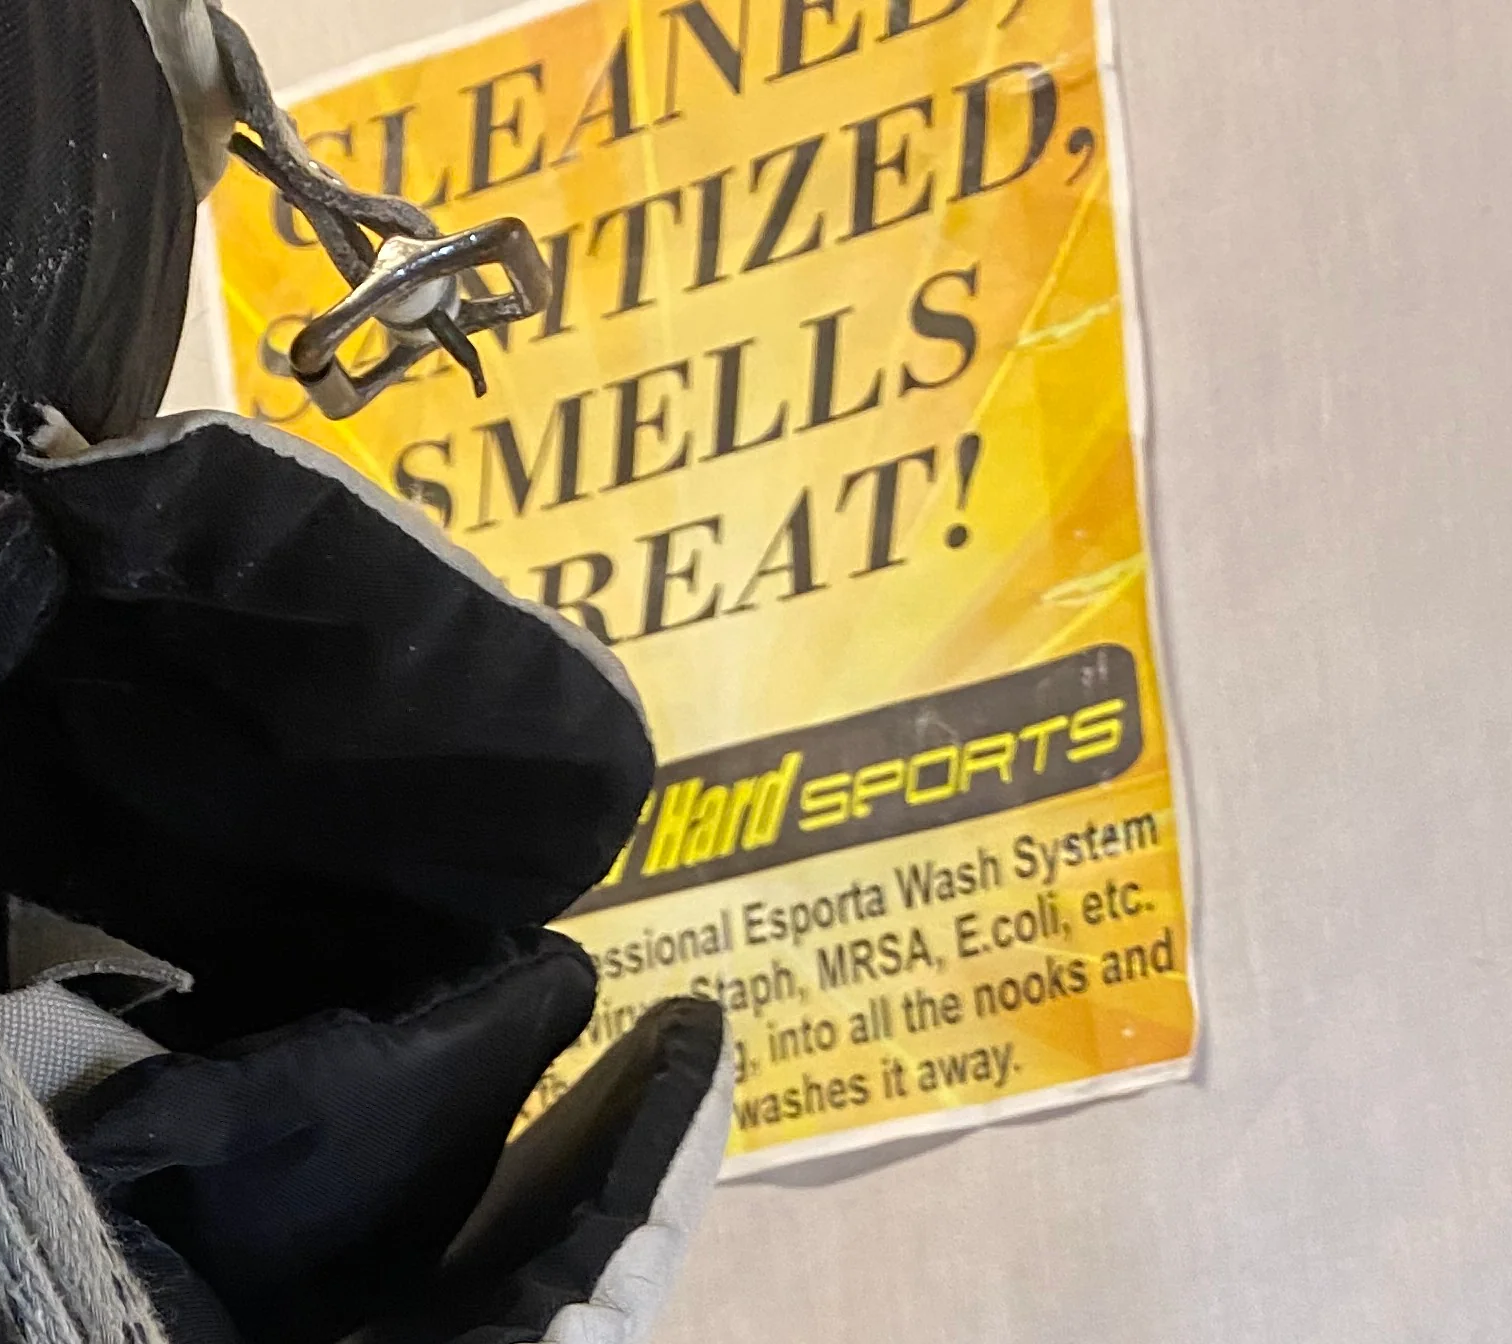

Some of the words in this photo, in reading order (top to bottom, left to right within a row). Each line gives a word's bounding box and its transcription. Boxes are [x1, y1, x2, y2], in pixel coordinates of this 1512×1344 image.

[256, 60, 1096, 424] SITIZED,
[390, 263, 985, 535] SMELLS
[522, 432, 982, 648] REAT!
[640, 750, 802, 878] Hard
[798, 698, 1126, 832] SPORTS
[742, 880, 886, 946] Esporta
[893, 846, 1003, 910] Wash
[1012, 811, 1159, 886] System
[816, 926, 947, 991] MRSA,
[954, 889, 1073, 958] E.coli,
[1081, 878, 1156, 925] etc.
[766, 1015, 839, 1063] into
[849, 993, 895, 1045] all
[901, 985, 964, 1034] the
[973, 954, 1090, 1009] nooks
[1101, 924, 1175, 985] and
[732, 1071, 870, 1130] washes
[881, 1054, 906, 1099] it
[916, 1041, 1022, 1089] away.
